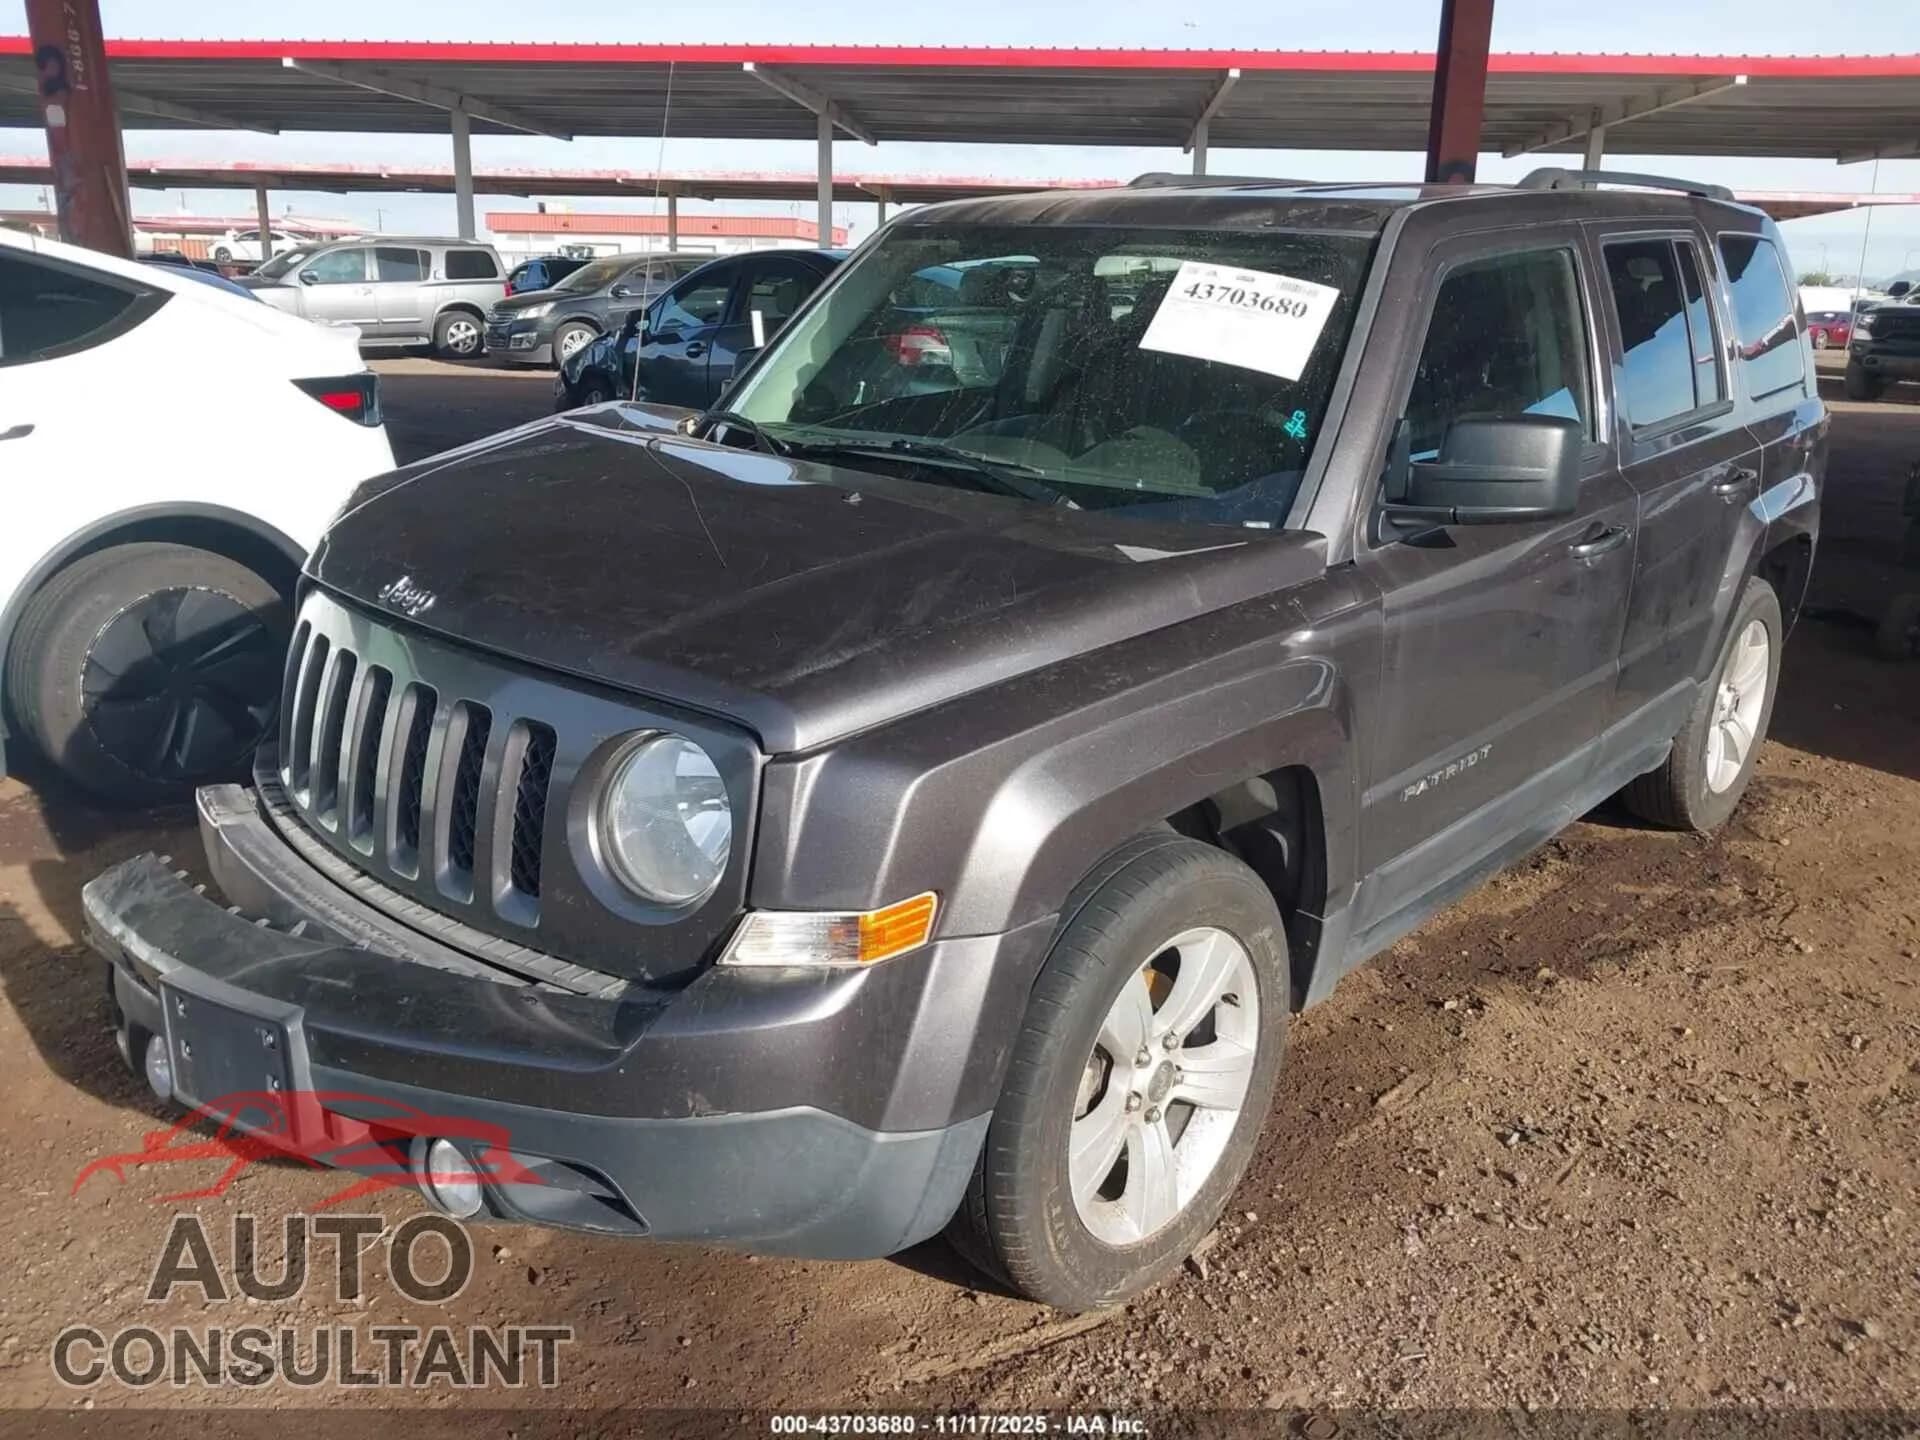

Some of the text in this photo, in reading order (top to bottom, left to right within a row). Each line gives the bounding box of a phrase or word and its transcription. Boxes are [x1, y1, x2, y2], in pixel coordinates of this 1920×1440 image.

[1183, 281, 1308, 319] 43703680
[378, 575, 437, 616] Jeep
[1401, 743, 1493, 803] PATRIOT
